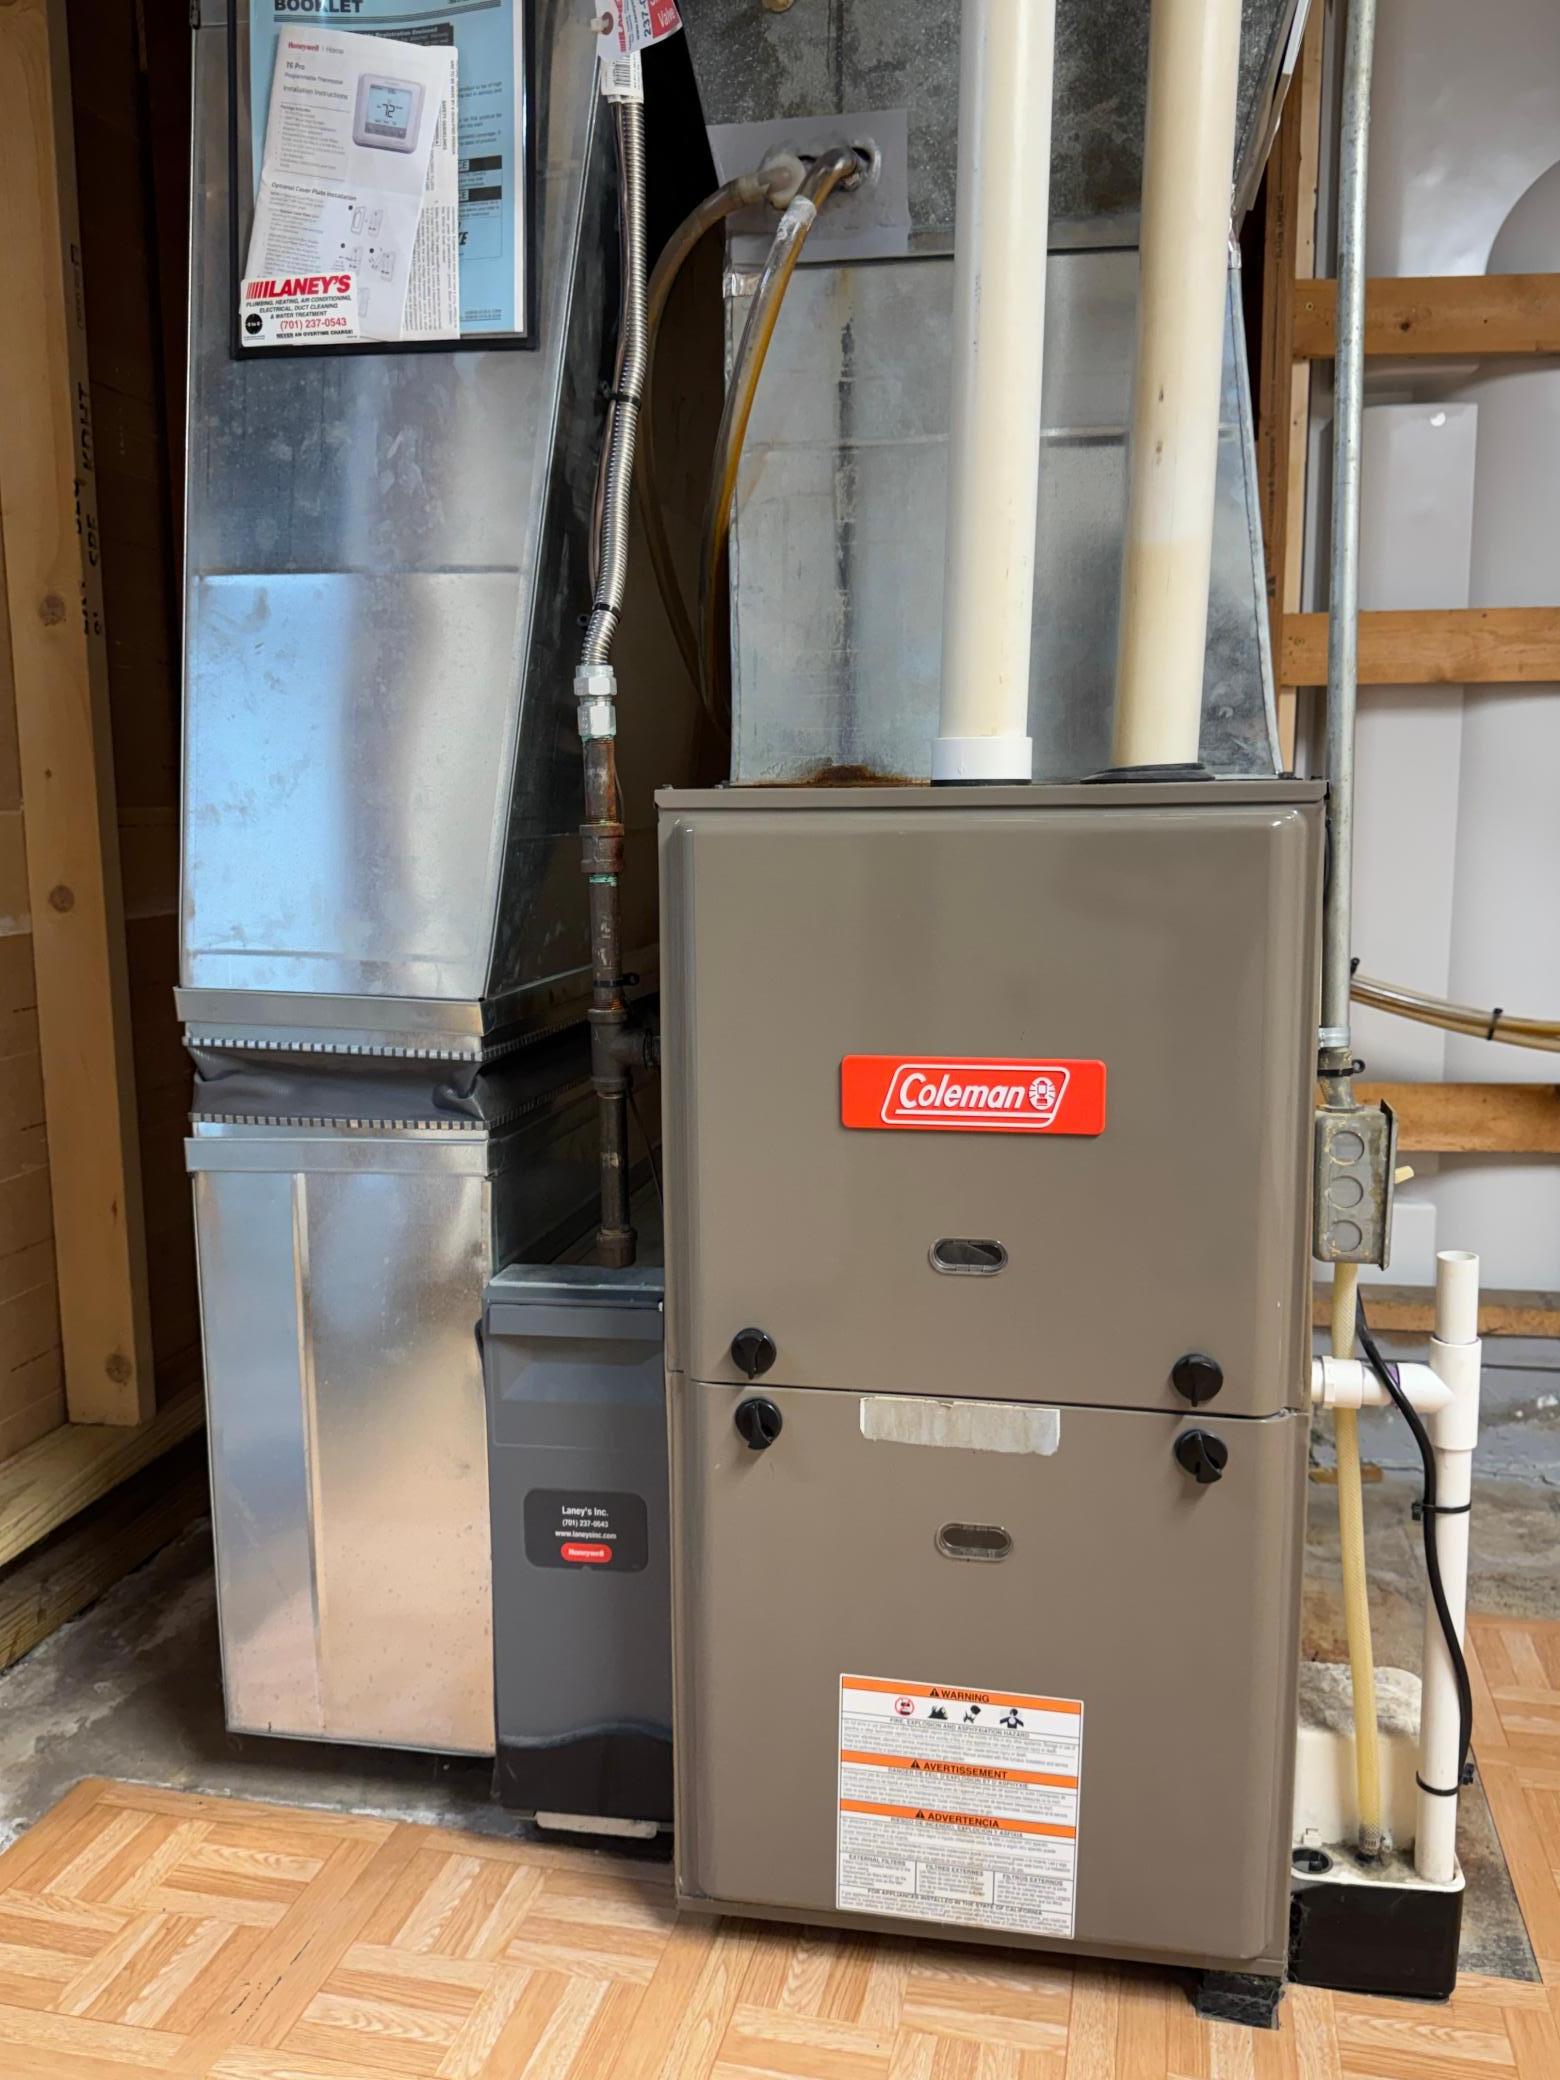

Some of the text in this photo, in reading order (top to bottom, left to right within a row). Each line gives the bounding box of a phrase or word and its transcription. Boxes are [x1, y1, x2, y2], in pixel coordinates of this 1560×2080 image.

[268, 274, 352, 298] LANEY'S
[280, 317, 347, 331] (701) 237-0543
[899, 1072, 1026, 1109] Coleman
[562, 1505, 609, 1517] Laney's Inc.
[562, 1519, 609, 1528] (701) 237-0543
[555, 1530, 617, 1540] www.laneysinc.com
[568, 1548, 605, 1557] Honeywell
[940, 1690, 990, 1703] WARNING
[923, 1762, 1008, 1779] AVERTISSEMENT
[928, 1812, 1000, 1828] ADVERTENCIA
